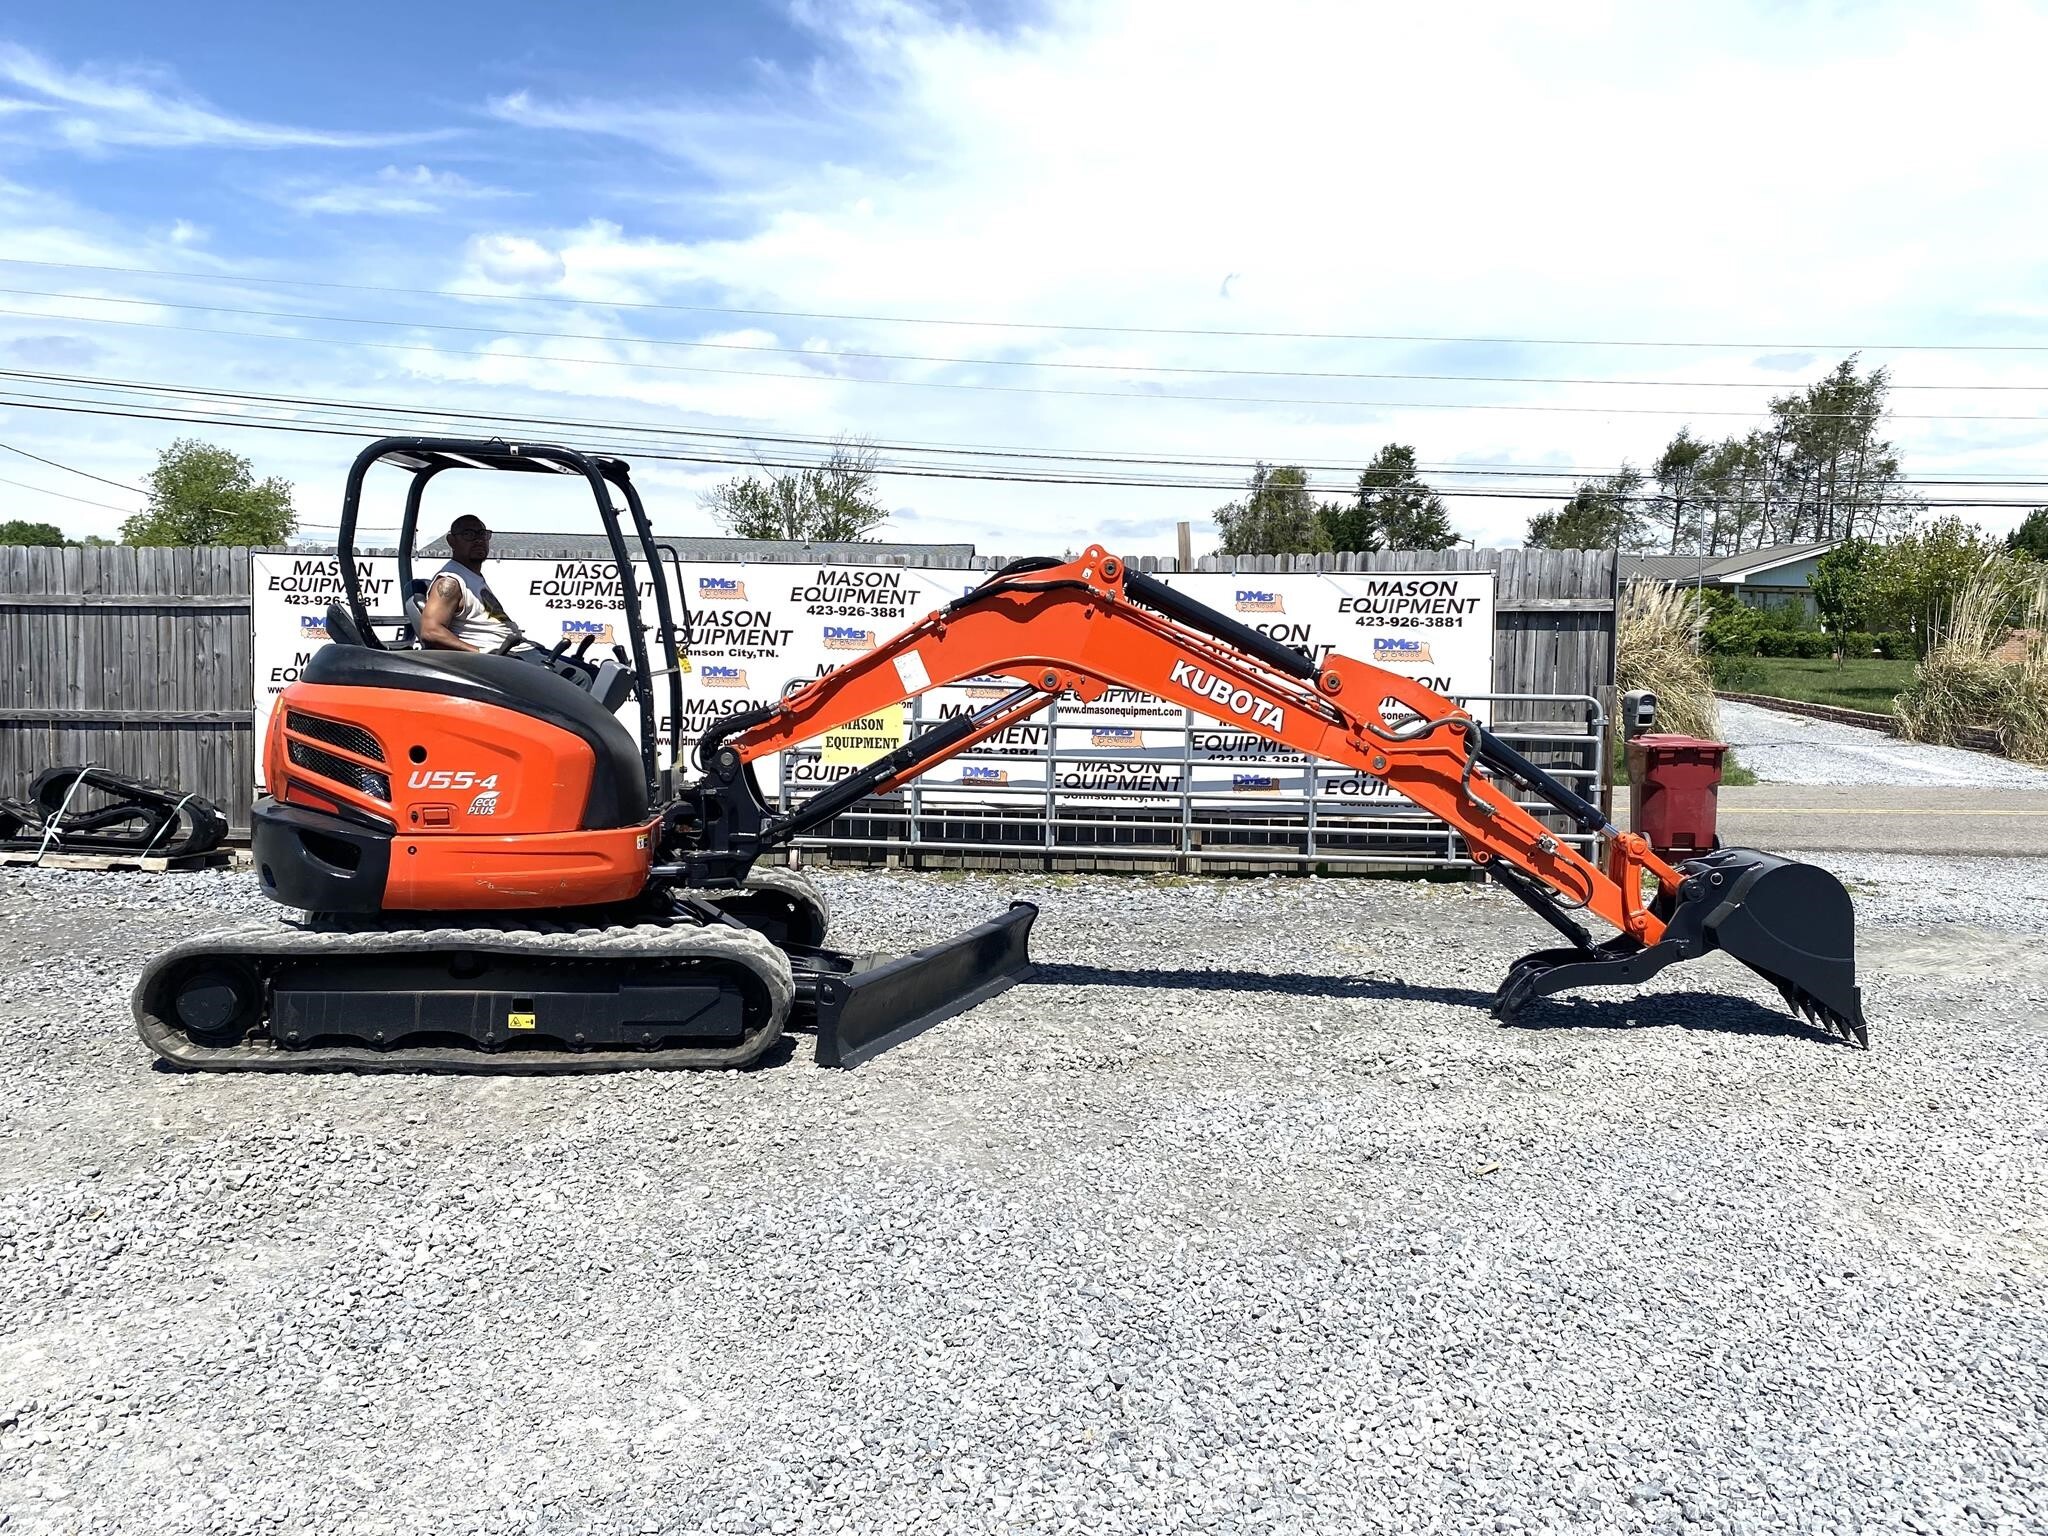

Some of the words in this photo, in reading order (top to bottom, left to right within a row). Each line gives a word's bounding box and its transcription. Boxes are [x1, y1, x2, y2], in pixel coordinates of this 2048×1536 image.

[293, 561, 373, 577] MASN
[555, 564, 636, 579] MASO
[268, 576, 393, 594] EQUIPMNT
[816, 570, 900, 588] MASON
[790, 587, 921, 605] EQUIPMENT
[1367, 581, 1458, 597] MASON
[285, 595, 379, 607] 423-926-81
[545, 599, 642, 610] 423-926-381
[1338, 597, 1480, 614] EQUIPMENT
[806, 605, 905, 618] 423-926-3881
[683, 610, 771, 628] MASON
[1356, 616, 1463, 628] 423-926-3881
[1255, 623, 1311, 642] SON
[685, 649, 724, 657] hnson
[728, 649, 779, 659] City,TN.
[1169, 659, 1285, 734] KUBOTA
[1057, 706, 1182, 717] www.dmasonequipment.com
[841, 719, 884, 731] MASON
[826, 736, 899, 750] EQUIPMENT
[1207, 755, 1308, 763] 4239263881
[1076, 762, 1162, 774] MASON
[407, 770, 498, 789] U55-4
[1055, 773, 1185, 791] EQUIPMENT
[476, 798, 497, 807] eco
[467, 806, 495, 815] PLUS
